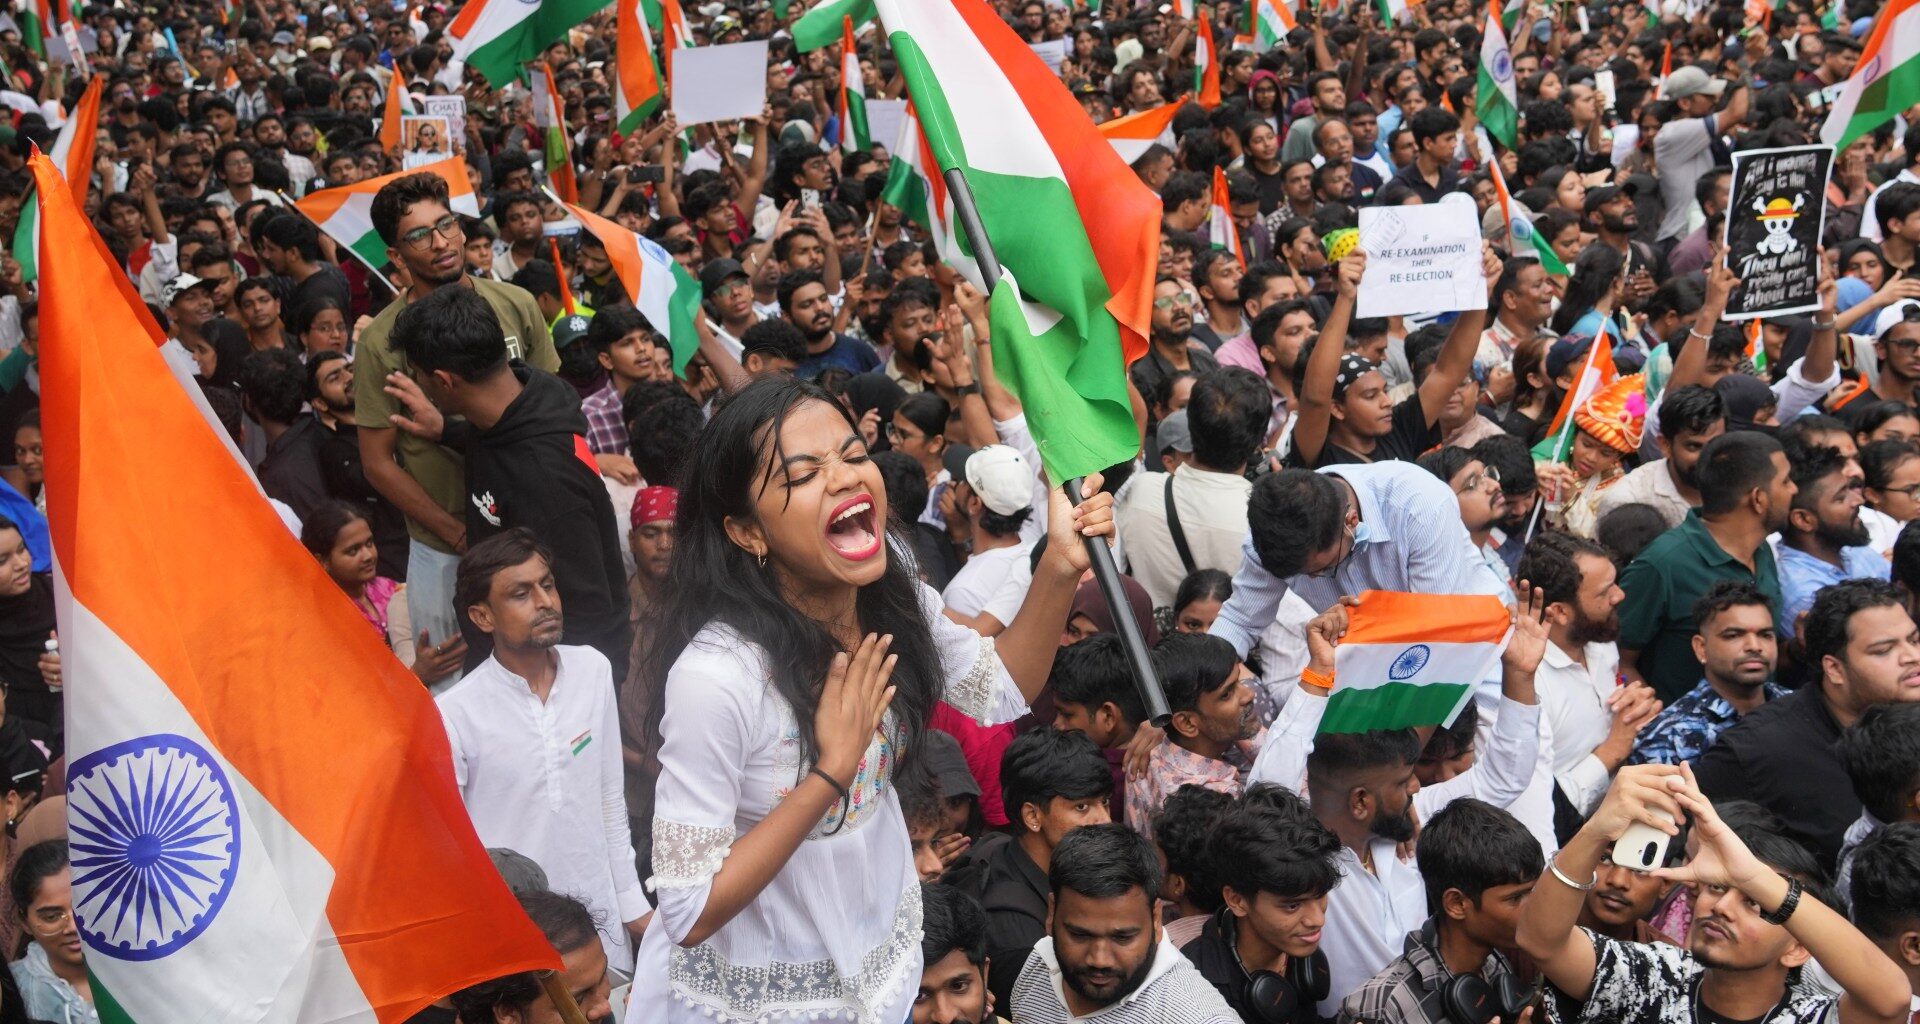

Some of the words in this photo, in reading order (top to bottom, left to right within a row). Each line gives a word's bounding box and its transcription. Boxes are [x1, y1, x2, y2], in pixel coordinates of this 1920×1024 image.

[1422, 234, 1429, 242] IF
[1380, 244, 1466, 258] RE-EXAMINATION
[1411, 259, 1432, 268] THEN
[1390, 270, 1453, 283] RE-ELECTION
